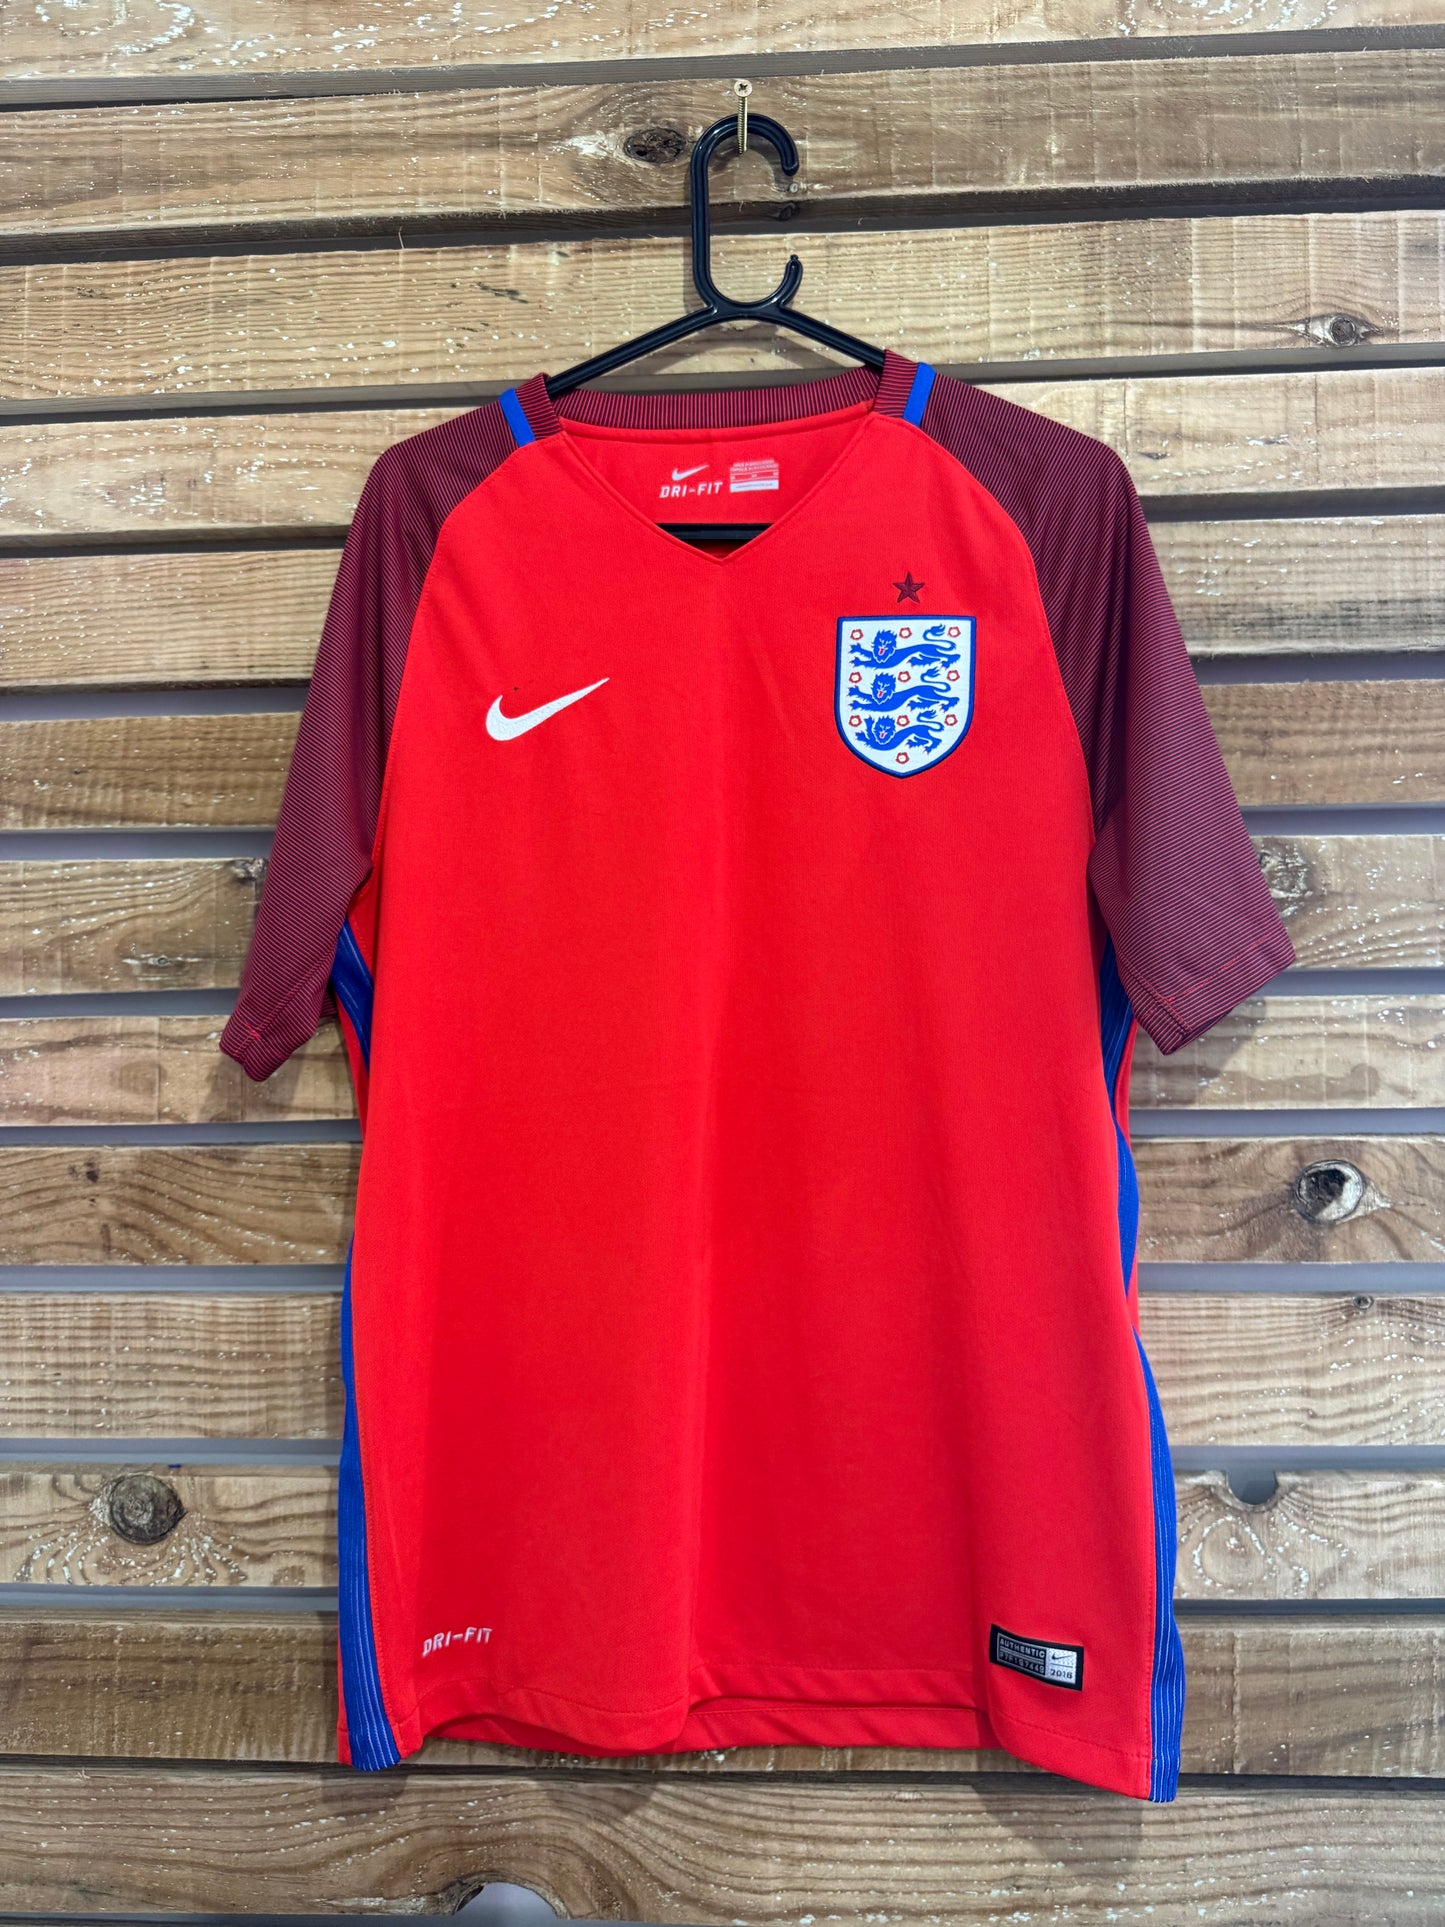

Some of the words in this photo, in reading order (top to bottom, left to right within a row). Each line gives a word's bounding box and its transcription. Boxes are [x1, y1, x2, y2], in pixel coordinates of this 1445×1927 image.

[659, 481, 723, 498] DRI-FIT
[422, 1626, 493, 1657] DRI-FIT
[1000, 1638, 1045, 1658] AUTHENTIC
[1051, 1669, 1073, 1679] 2016
